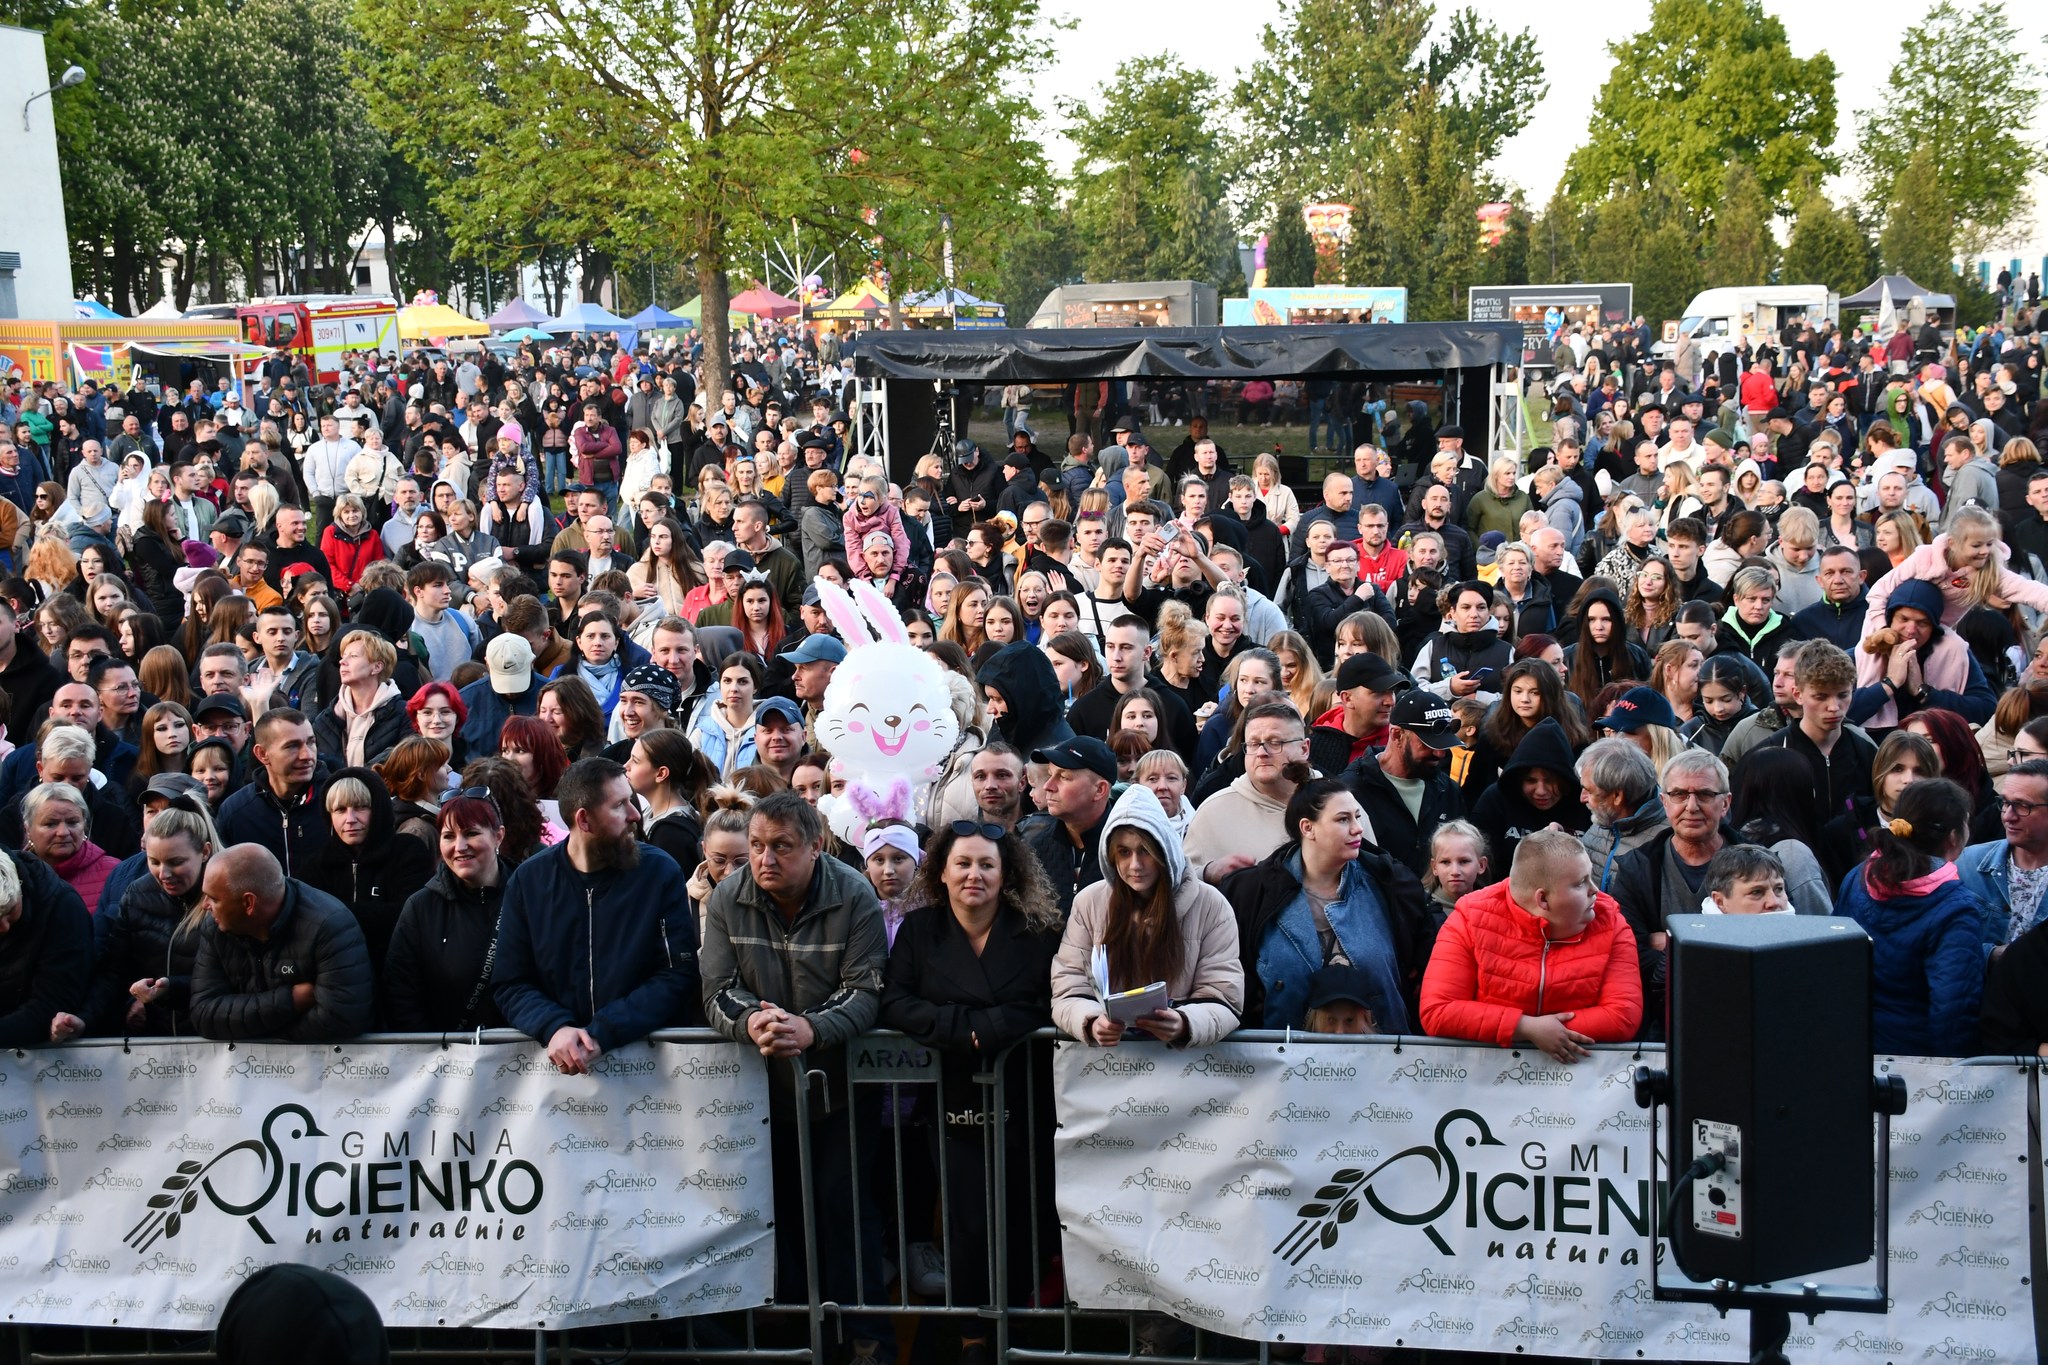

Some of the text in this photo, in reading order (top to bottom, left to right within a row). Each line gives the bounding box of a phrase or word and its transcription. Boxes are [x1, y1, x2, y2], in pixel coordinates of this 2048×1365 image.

[452, 552, 468, 572] P
[281, 965, 294, 974] CK
[857, 1050, 932, 1068] ARAD
[1712, 1123, 1732, 1132] KOZAK
[342, 1128, 514, 1158] GMINA
[1520, 1141, 1667, 1174] GMI
[305, 1216, 526, 1244] naturalnie
